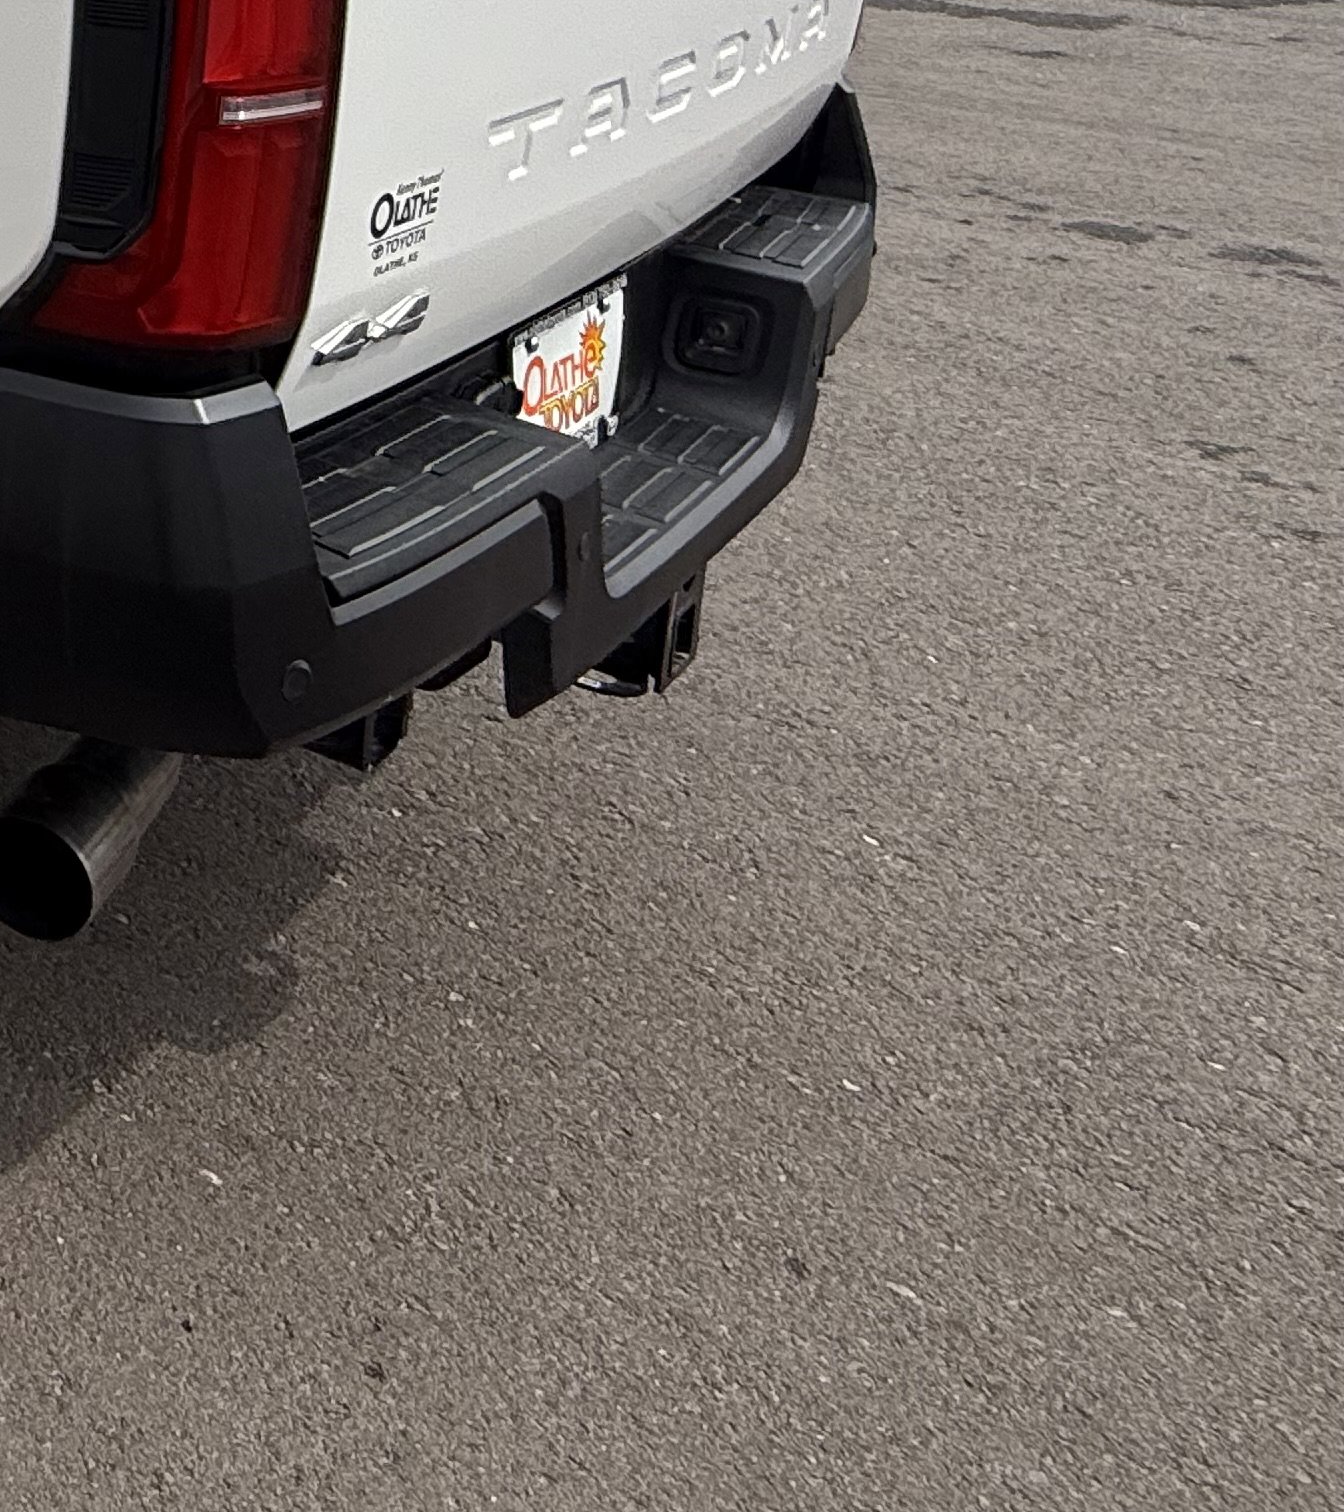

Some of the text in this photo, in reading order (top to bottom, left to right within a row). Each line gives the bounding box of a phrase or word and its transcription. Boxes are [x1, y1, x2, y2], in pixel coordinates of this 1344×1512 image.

[370, 186, 440, 240] OLATHE
[385, 227, 426, 255] TOYOTA
[539, 375, 600, 432] TOYOTA
